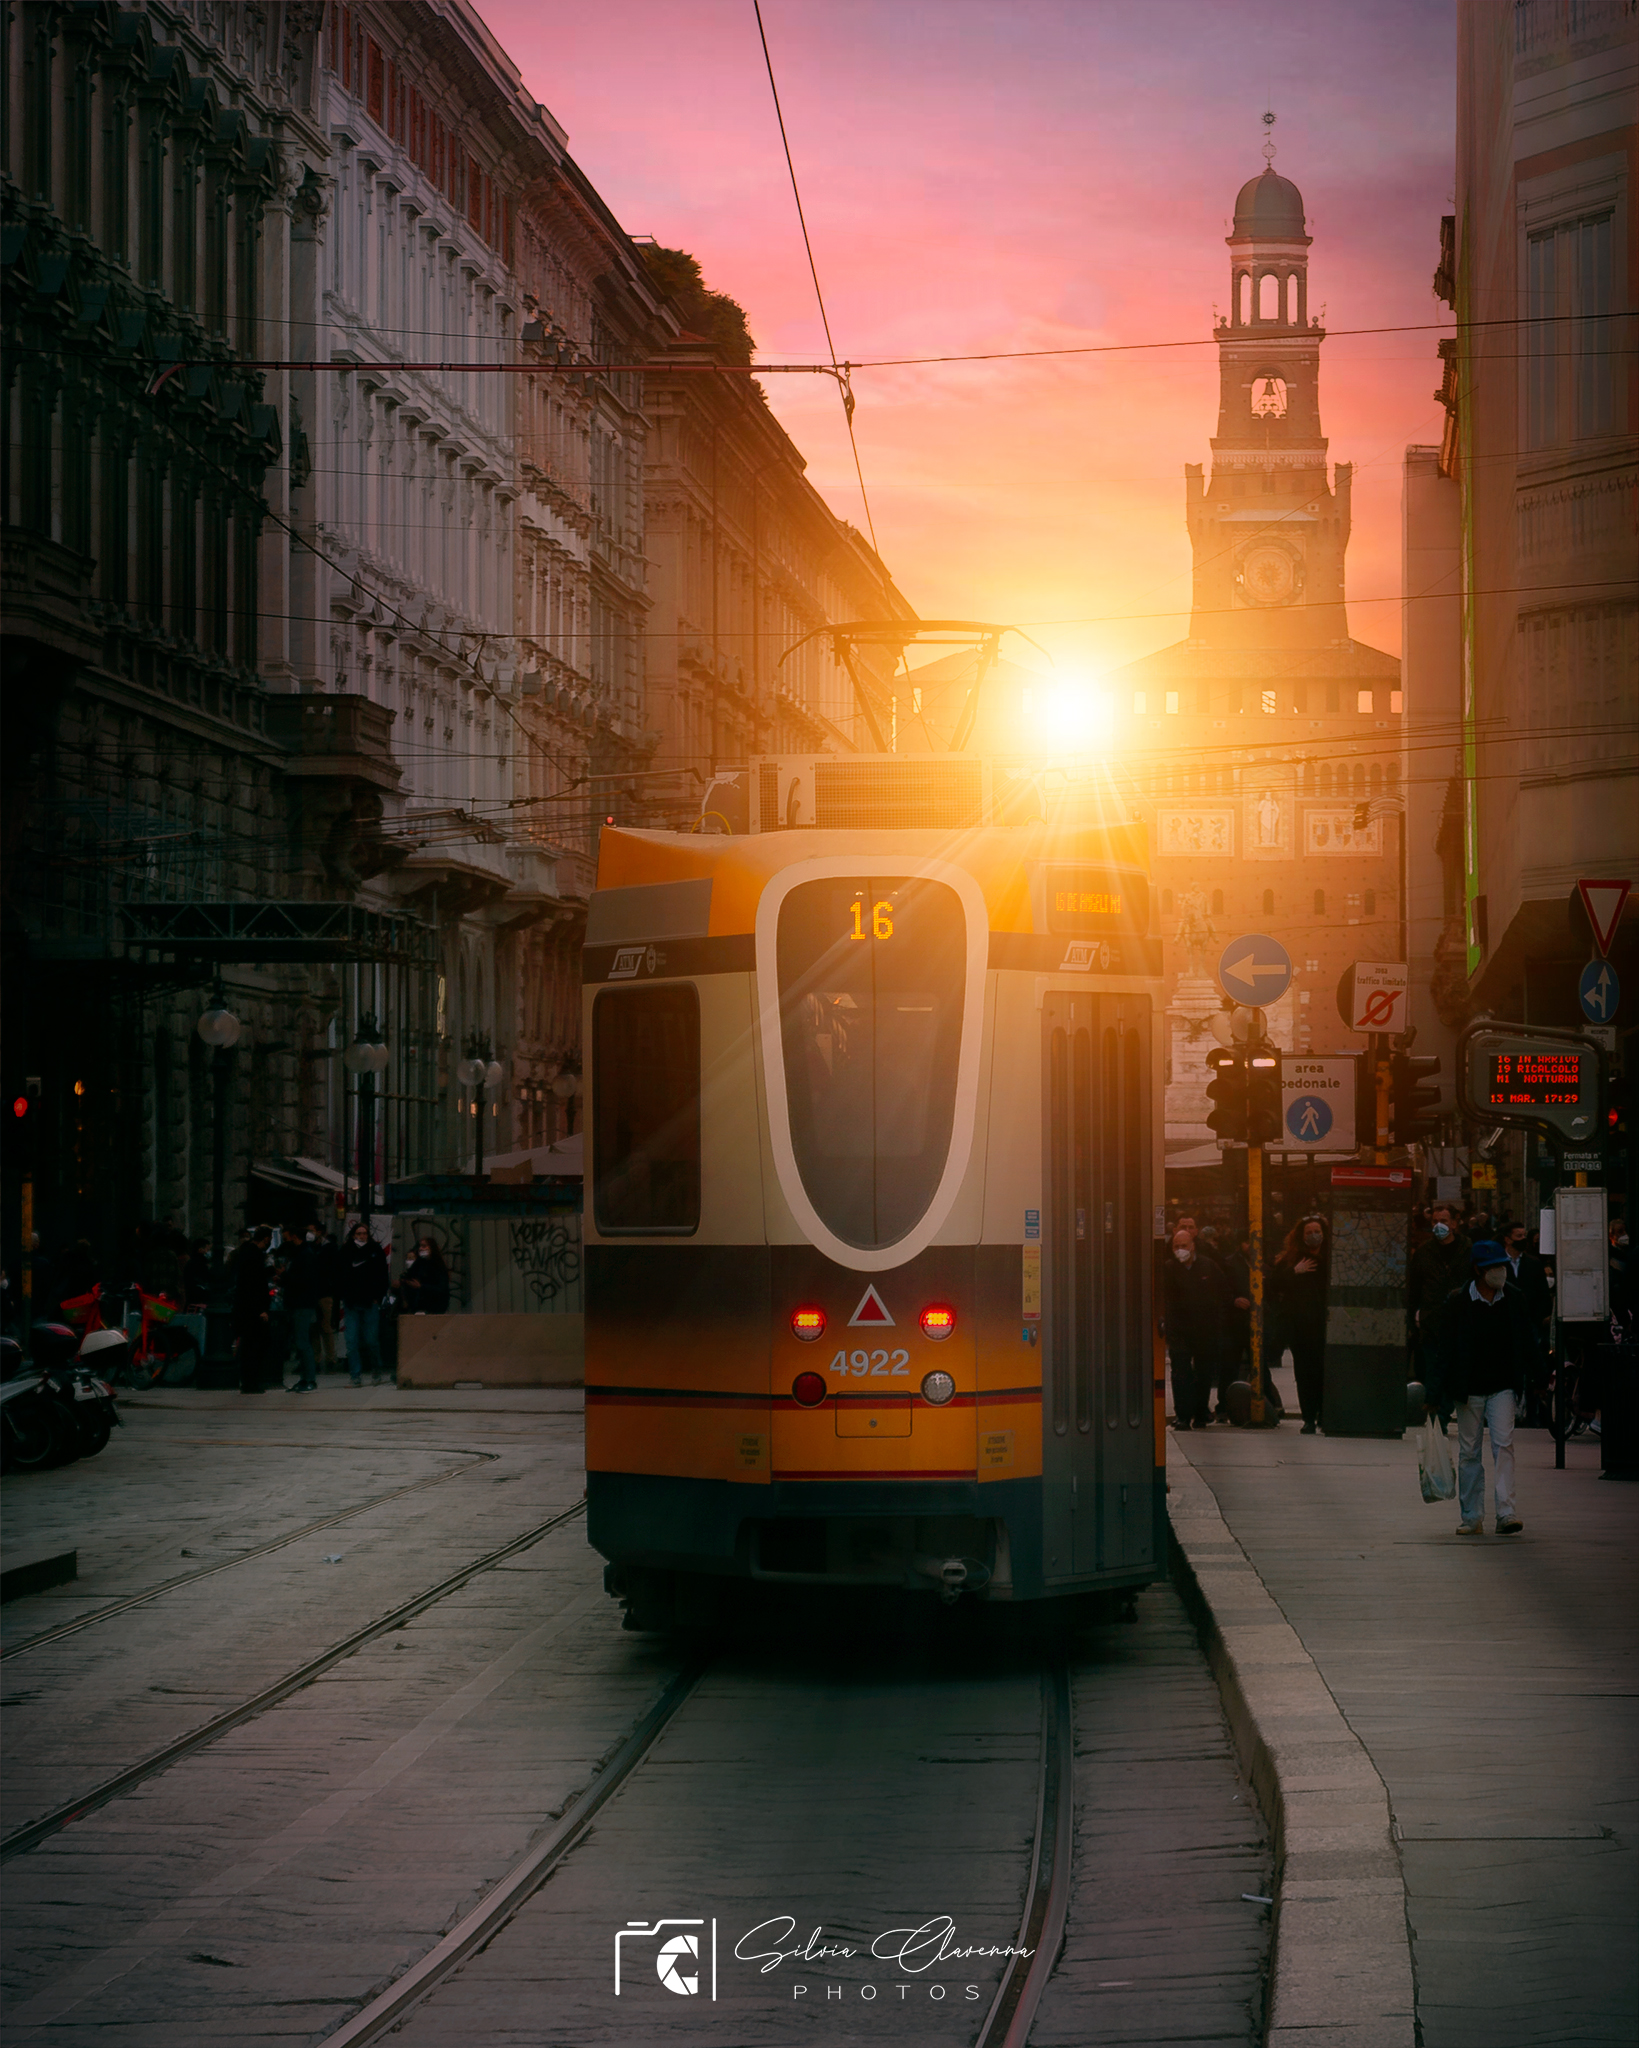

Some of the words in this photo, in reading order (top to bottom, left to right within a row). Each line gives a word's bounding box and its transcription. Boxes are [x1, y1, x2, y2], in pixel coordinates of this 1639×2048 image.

[849, 901, 894, 940] 16
[1374, 967, 1388, 975] zona
[1357, 976, 1380, 985] traffico
[1382, 977, 1407, 987] limitato
[1497, 1055, 1511, 1063] 16
[1518, 1055, 1532, 1063] IN
[1295, 1065, 1325, 1073] area
[1497, 1064, 1511, 1073] 19
[1517, 1064, 1579, 1073] RICALCOLO
[1496, 1074, 1510, 1083] M1
[1523, 1074, 1579, 1083] NOTTURNA
[1490, 1094, 1504, 1103] 13
[1509, 1094, 1536, 1103] MAR.
[1544, 1094, 1579, 1103] 17:29
[1563, 1151, 1592, 1160] Fermata
[829, 1349, 910, 1377] 4922
